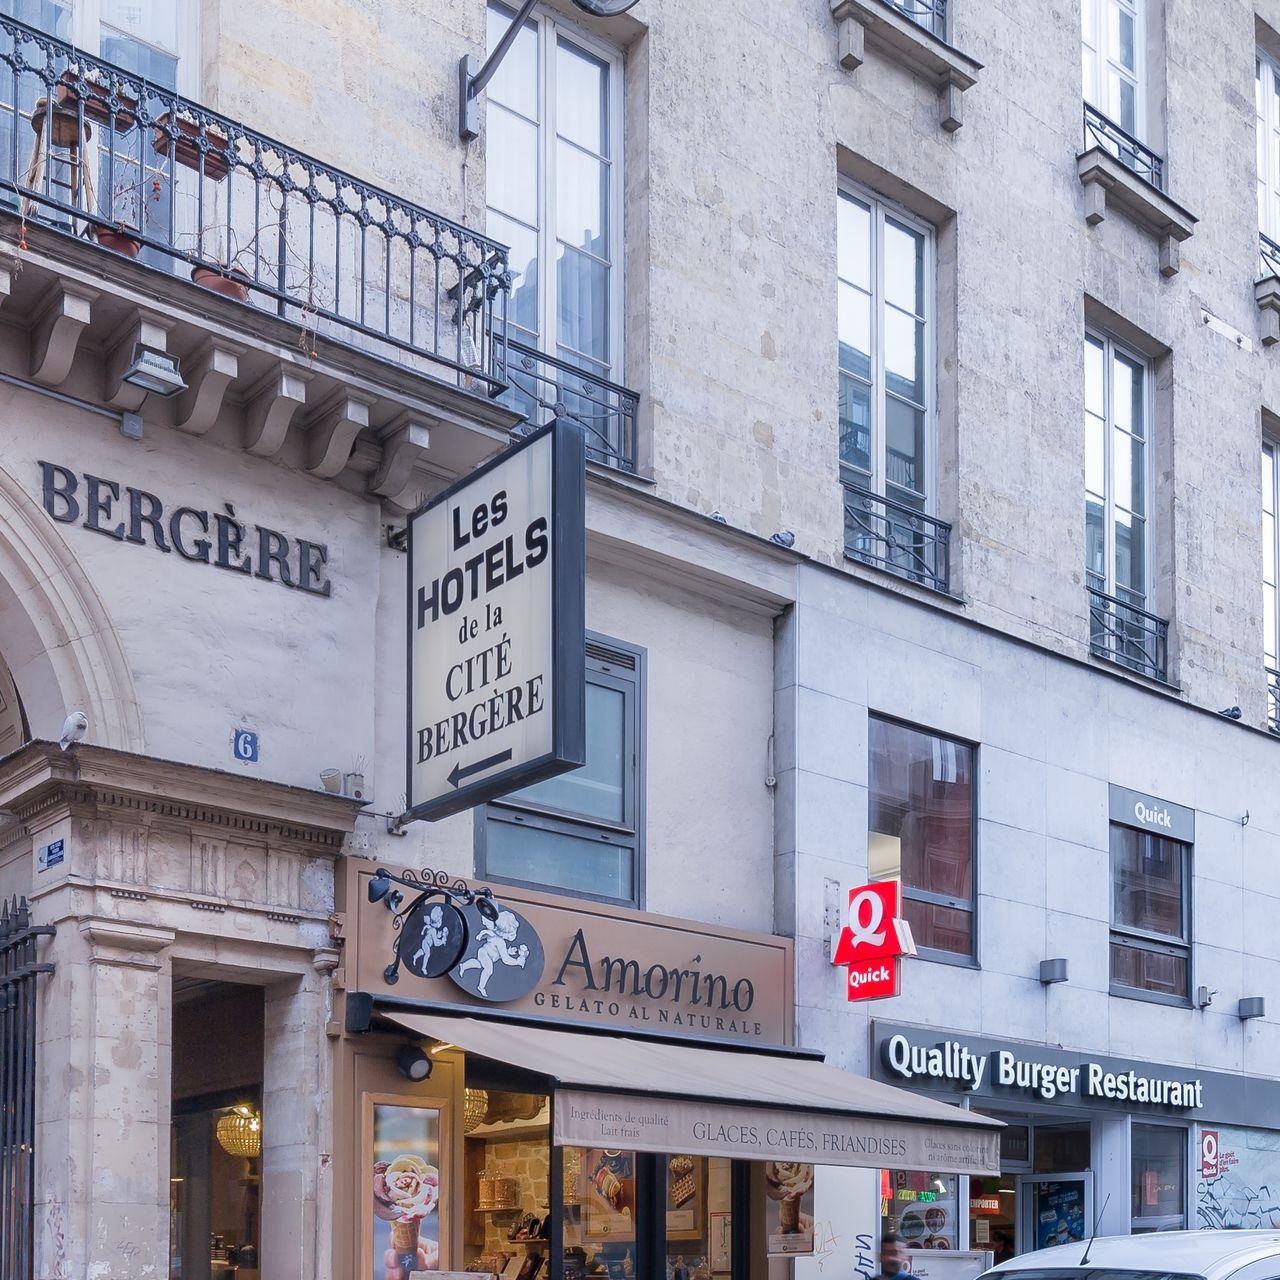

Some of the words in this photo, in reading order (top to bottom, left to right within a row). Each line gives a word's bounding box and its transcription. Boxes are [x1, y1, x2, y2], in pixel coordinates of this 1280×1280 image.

[38, 459, 331, 597] BERGÈRE
[452, 489, 509, 552] Les
[416, 516, 549, 630] HOTELS
[458, 615, 479, 644] de
[484, 604, 504, 632] la
[445, 632, 513, 702] CITÉ
[416, 673, 545, 765] BERGÈRE
[237, 732, 254, 758] 6
[1135, 801, 1172, 829] Quick
[848, 890, 887, 949] Q
[552, 928, 755, 1013] Amorino
[849, 965, 890, 988] Quick
[534, 992, 620, 1016] GELATO
[628, 1004, 650, 1020] AL
[658, 1009, 762, 1036] NATURALE
[887, 1034, 987, 1091] Quality
[997, 1050, 1080, 1099] Burger
[1087, 1062, 1204, 1109] Restaurant
[570, 1106, 623, 1123] Ingrédients
[625, 1112, 636, 1123] de
[638, 1114, 669, 1127] qualité
[601, 1124, 618, 1136] Lait
[620, 1125, 640, 1138] frais
[692, 1122, 762, 1147] GLACES,
[766, 1128, 818, 1151] CAFÉS,
[823, 1132, 907, 1157] FRIANDISES
[1202, 1134, 1218, 1164] Q
